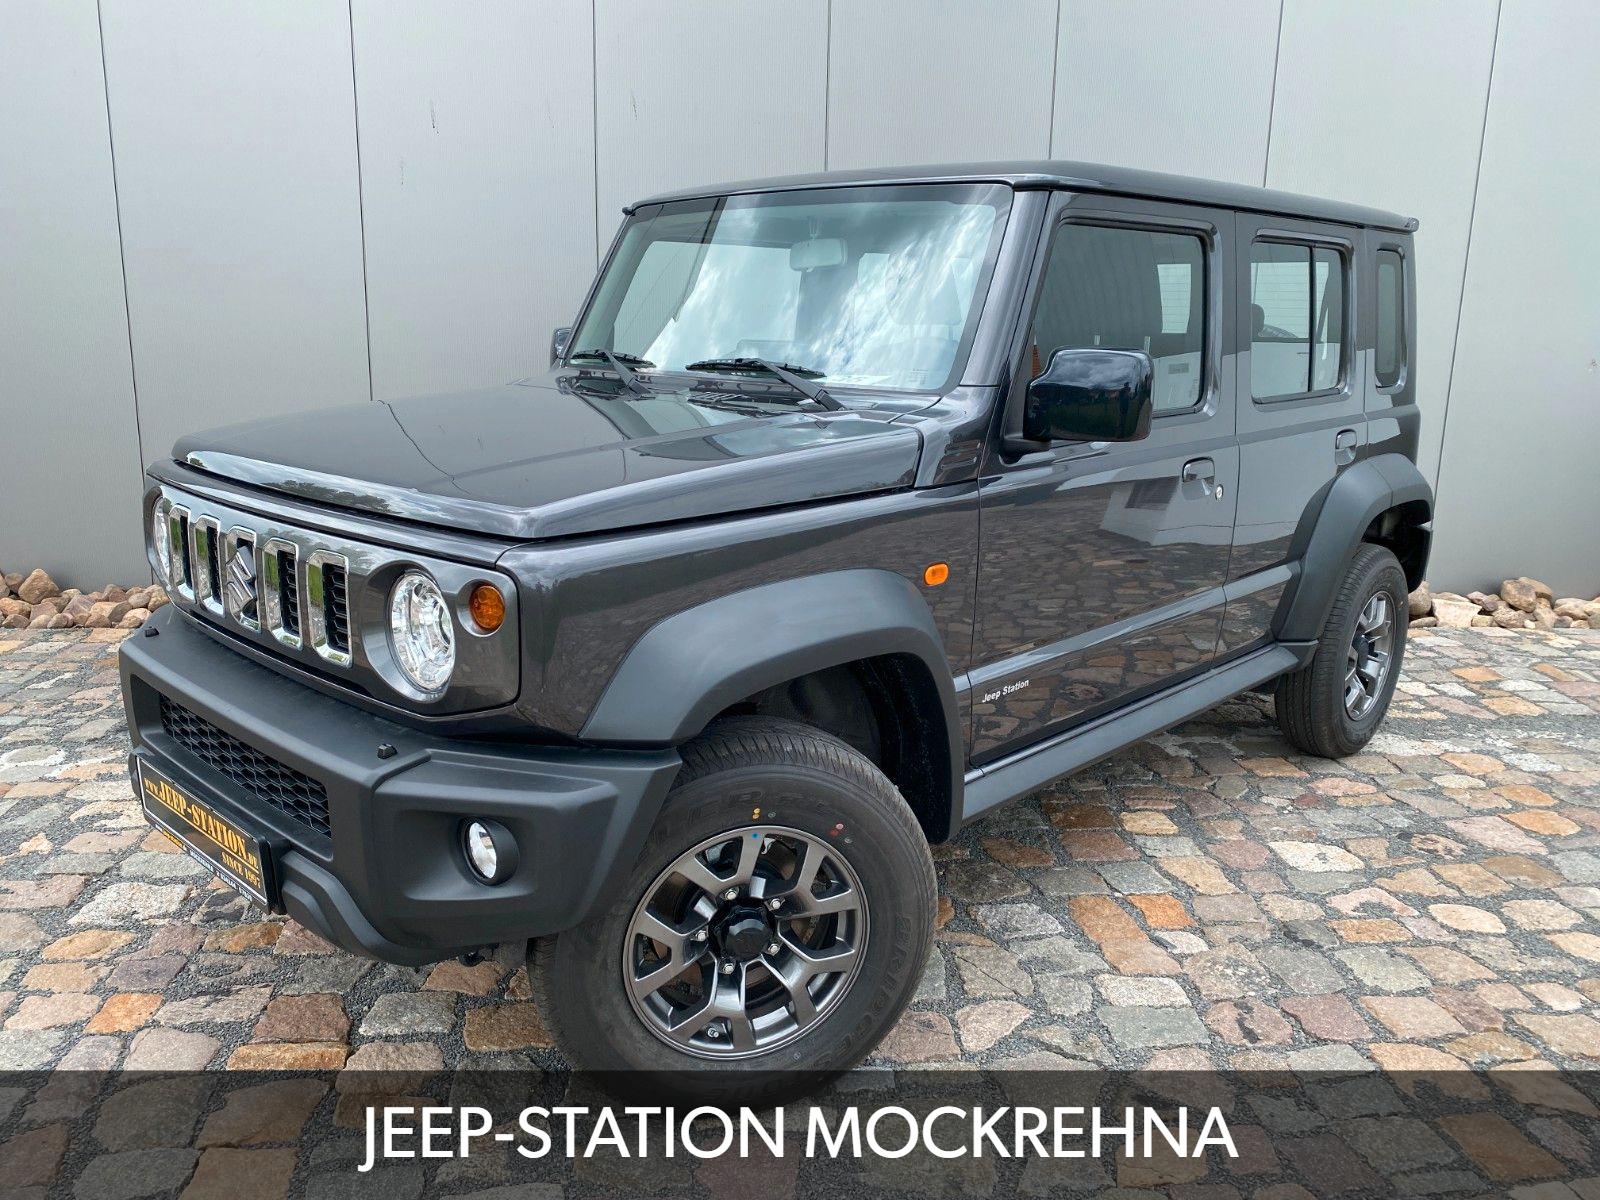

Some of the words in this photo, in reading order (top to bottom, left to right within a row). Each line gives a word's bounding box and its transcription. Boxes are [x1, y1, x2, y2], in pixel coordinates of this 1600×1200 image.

[981, 690, 1001, 703] Jeep
[1002, 679, 1030, 696] Station
[222, 851, 244, 876] SINCE
[244, 867, 261, 889] 1997
